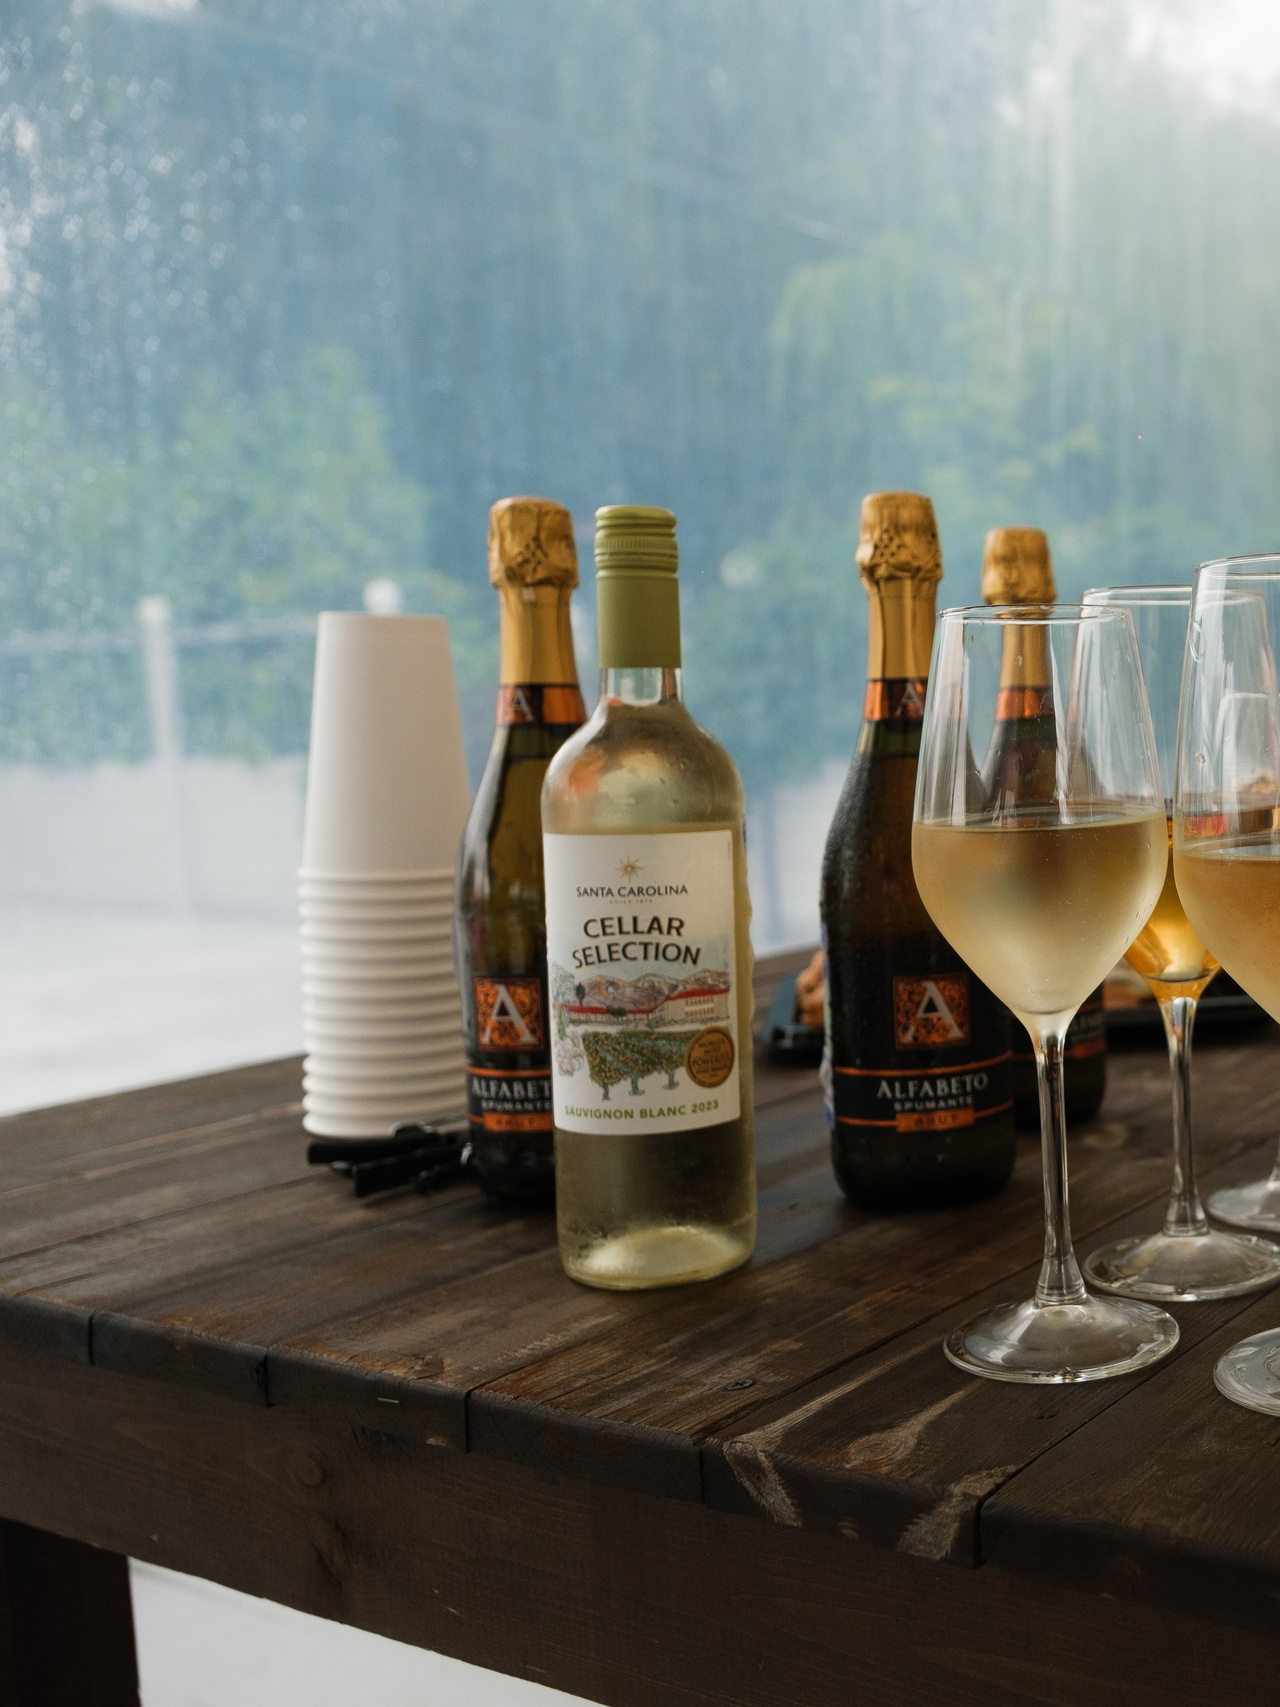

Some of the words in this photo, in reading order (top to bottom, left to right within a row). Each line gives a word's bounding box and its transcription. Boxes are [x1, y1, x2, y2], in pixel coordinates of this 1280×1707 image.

[894, 682, 925, 716] A
[576, 886, 615, 898] SANTA
[617, 884, 689, 898] CAROLINA
[583, 915, 685, 939] CELLAR
[571, 941, 702, 969] SELECTION
[480, 983, 538, 1045] A
[902, 980, 965, 1044] A
[472, 1076, 551, 1099] ALFABET
[876, 1072, 989, 1099] ALFABETO
[564, 1105, 635, 1120] SAUVIGNON
[639, 1105, 687, 1119] BLANC
[691, 1099, 719, 1114] 2023
[893, 1094, 974, 1112] SPUMANTE
